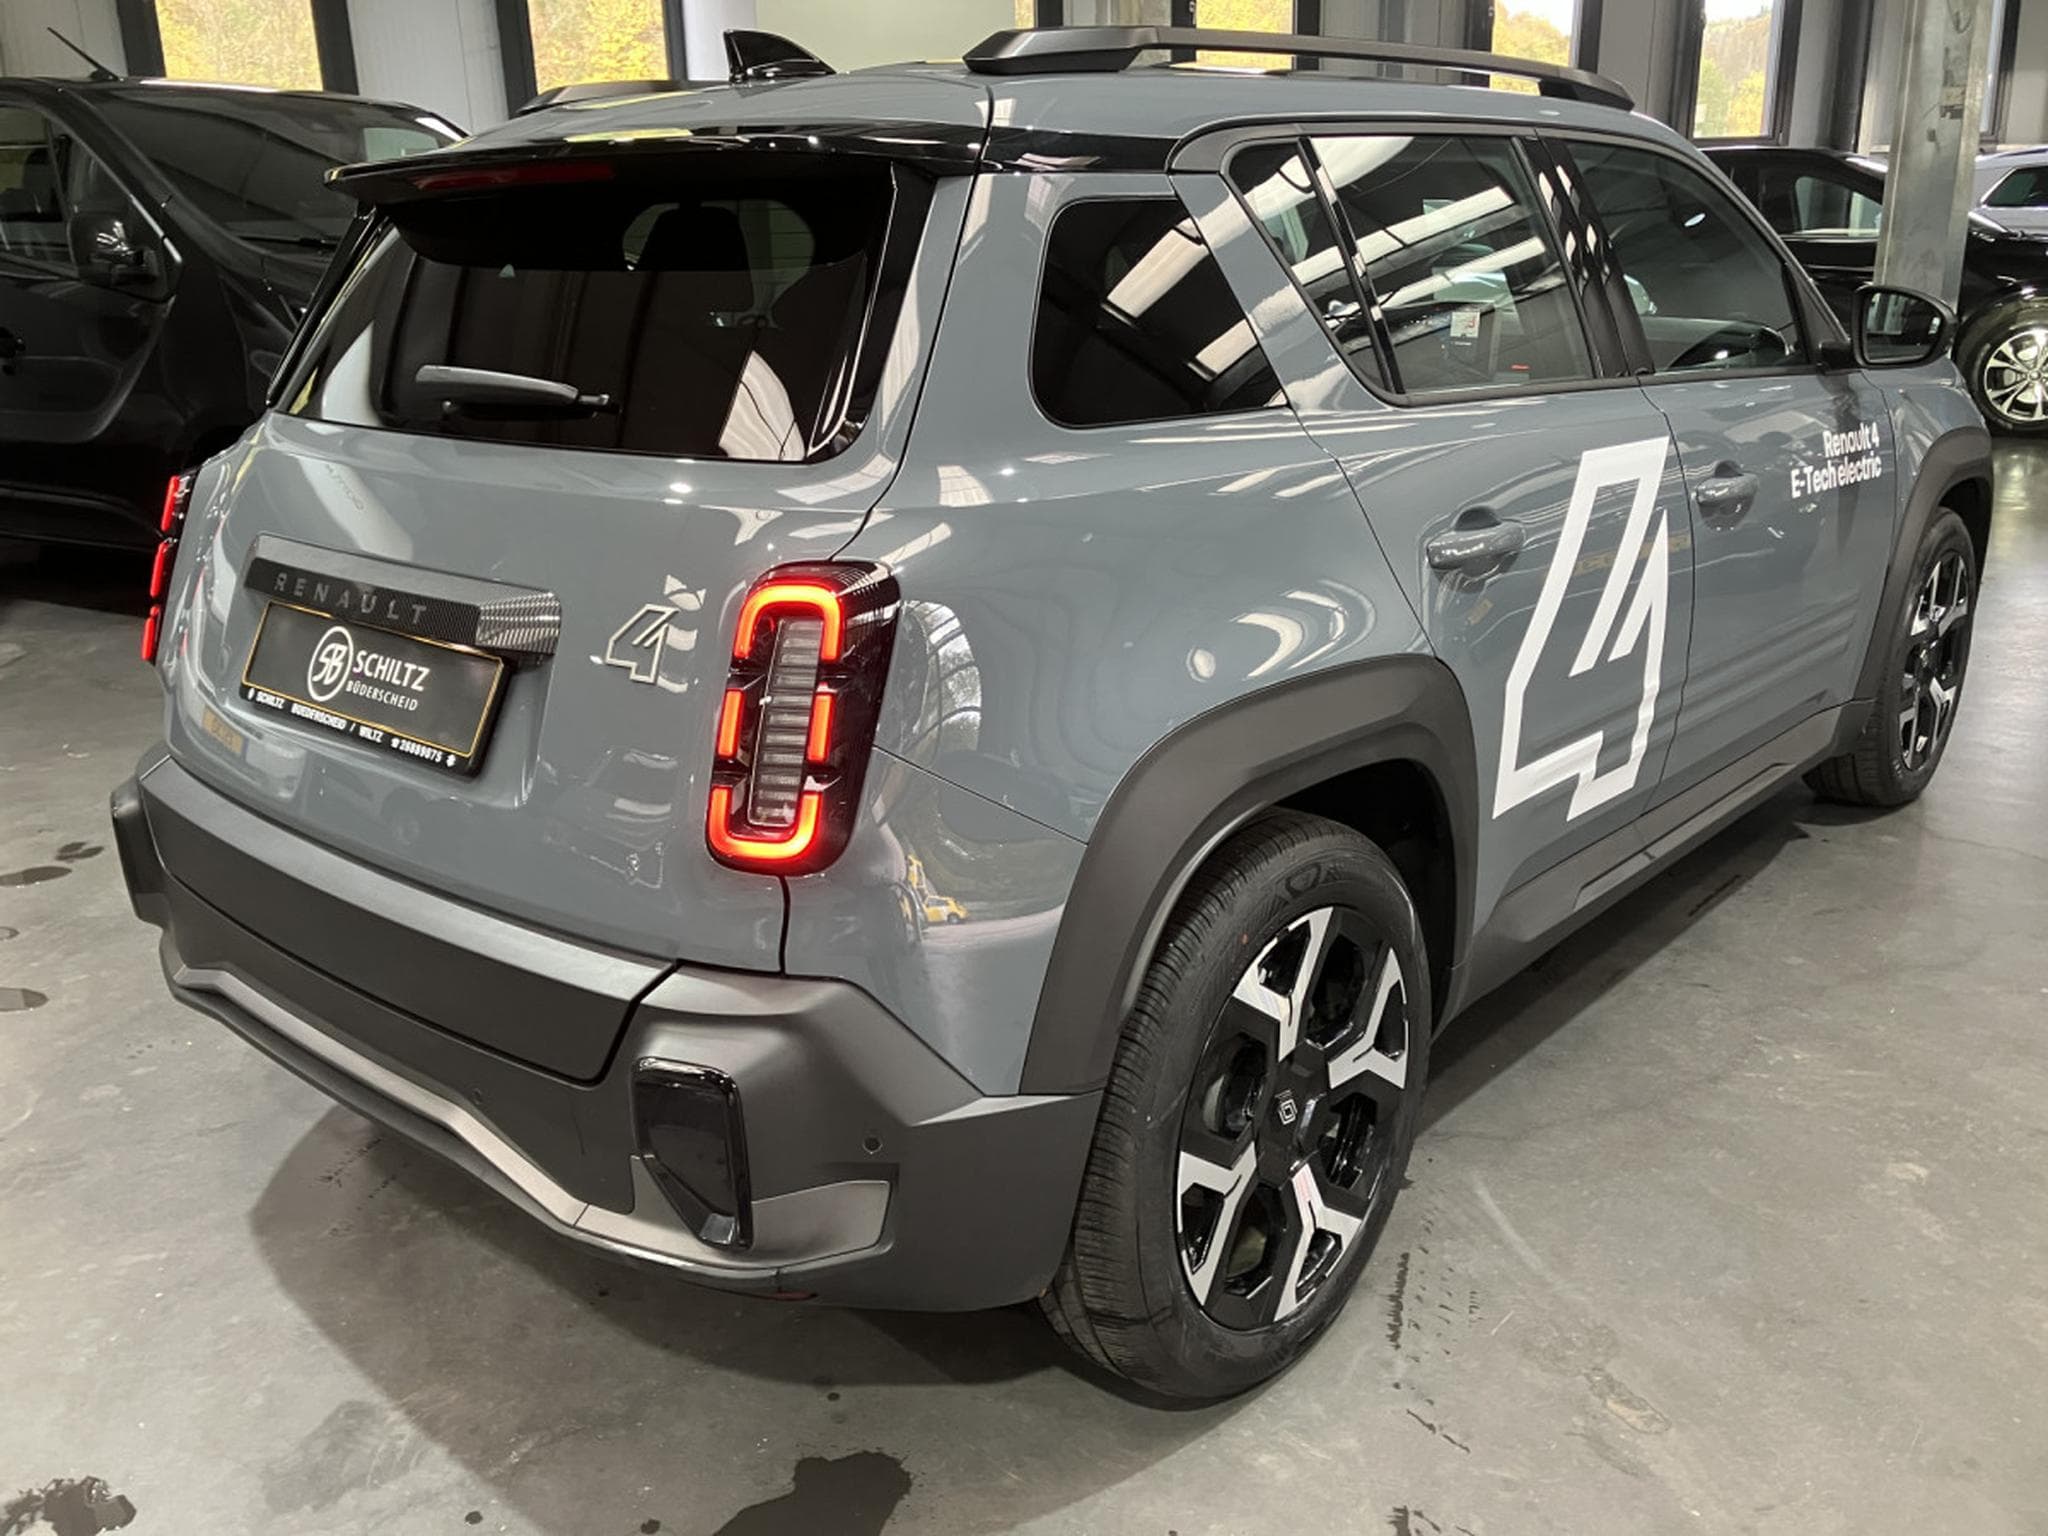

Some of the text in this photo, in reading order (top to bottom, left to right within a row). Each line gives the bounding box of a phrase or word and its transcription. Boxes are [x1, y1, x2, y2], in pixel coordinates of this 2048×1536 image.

[1823, 421, 1880, 458] Renault 4
[1791, 450, 1882, 499] E-Tech electric
[274, 572, 427, 624] RENAULT
[352, 650, 431, 692] SCHILTZ
[345, 680, 418, 711] BÜDERSCHEID
